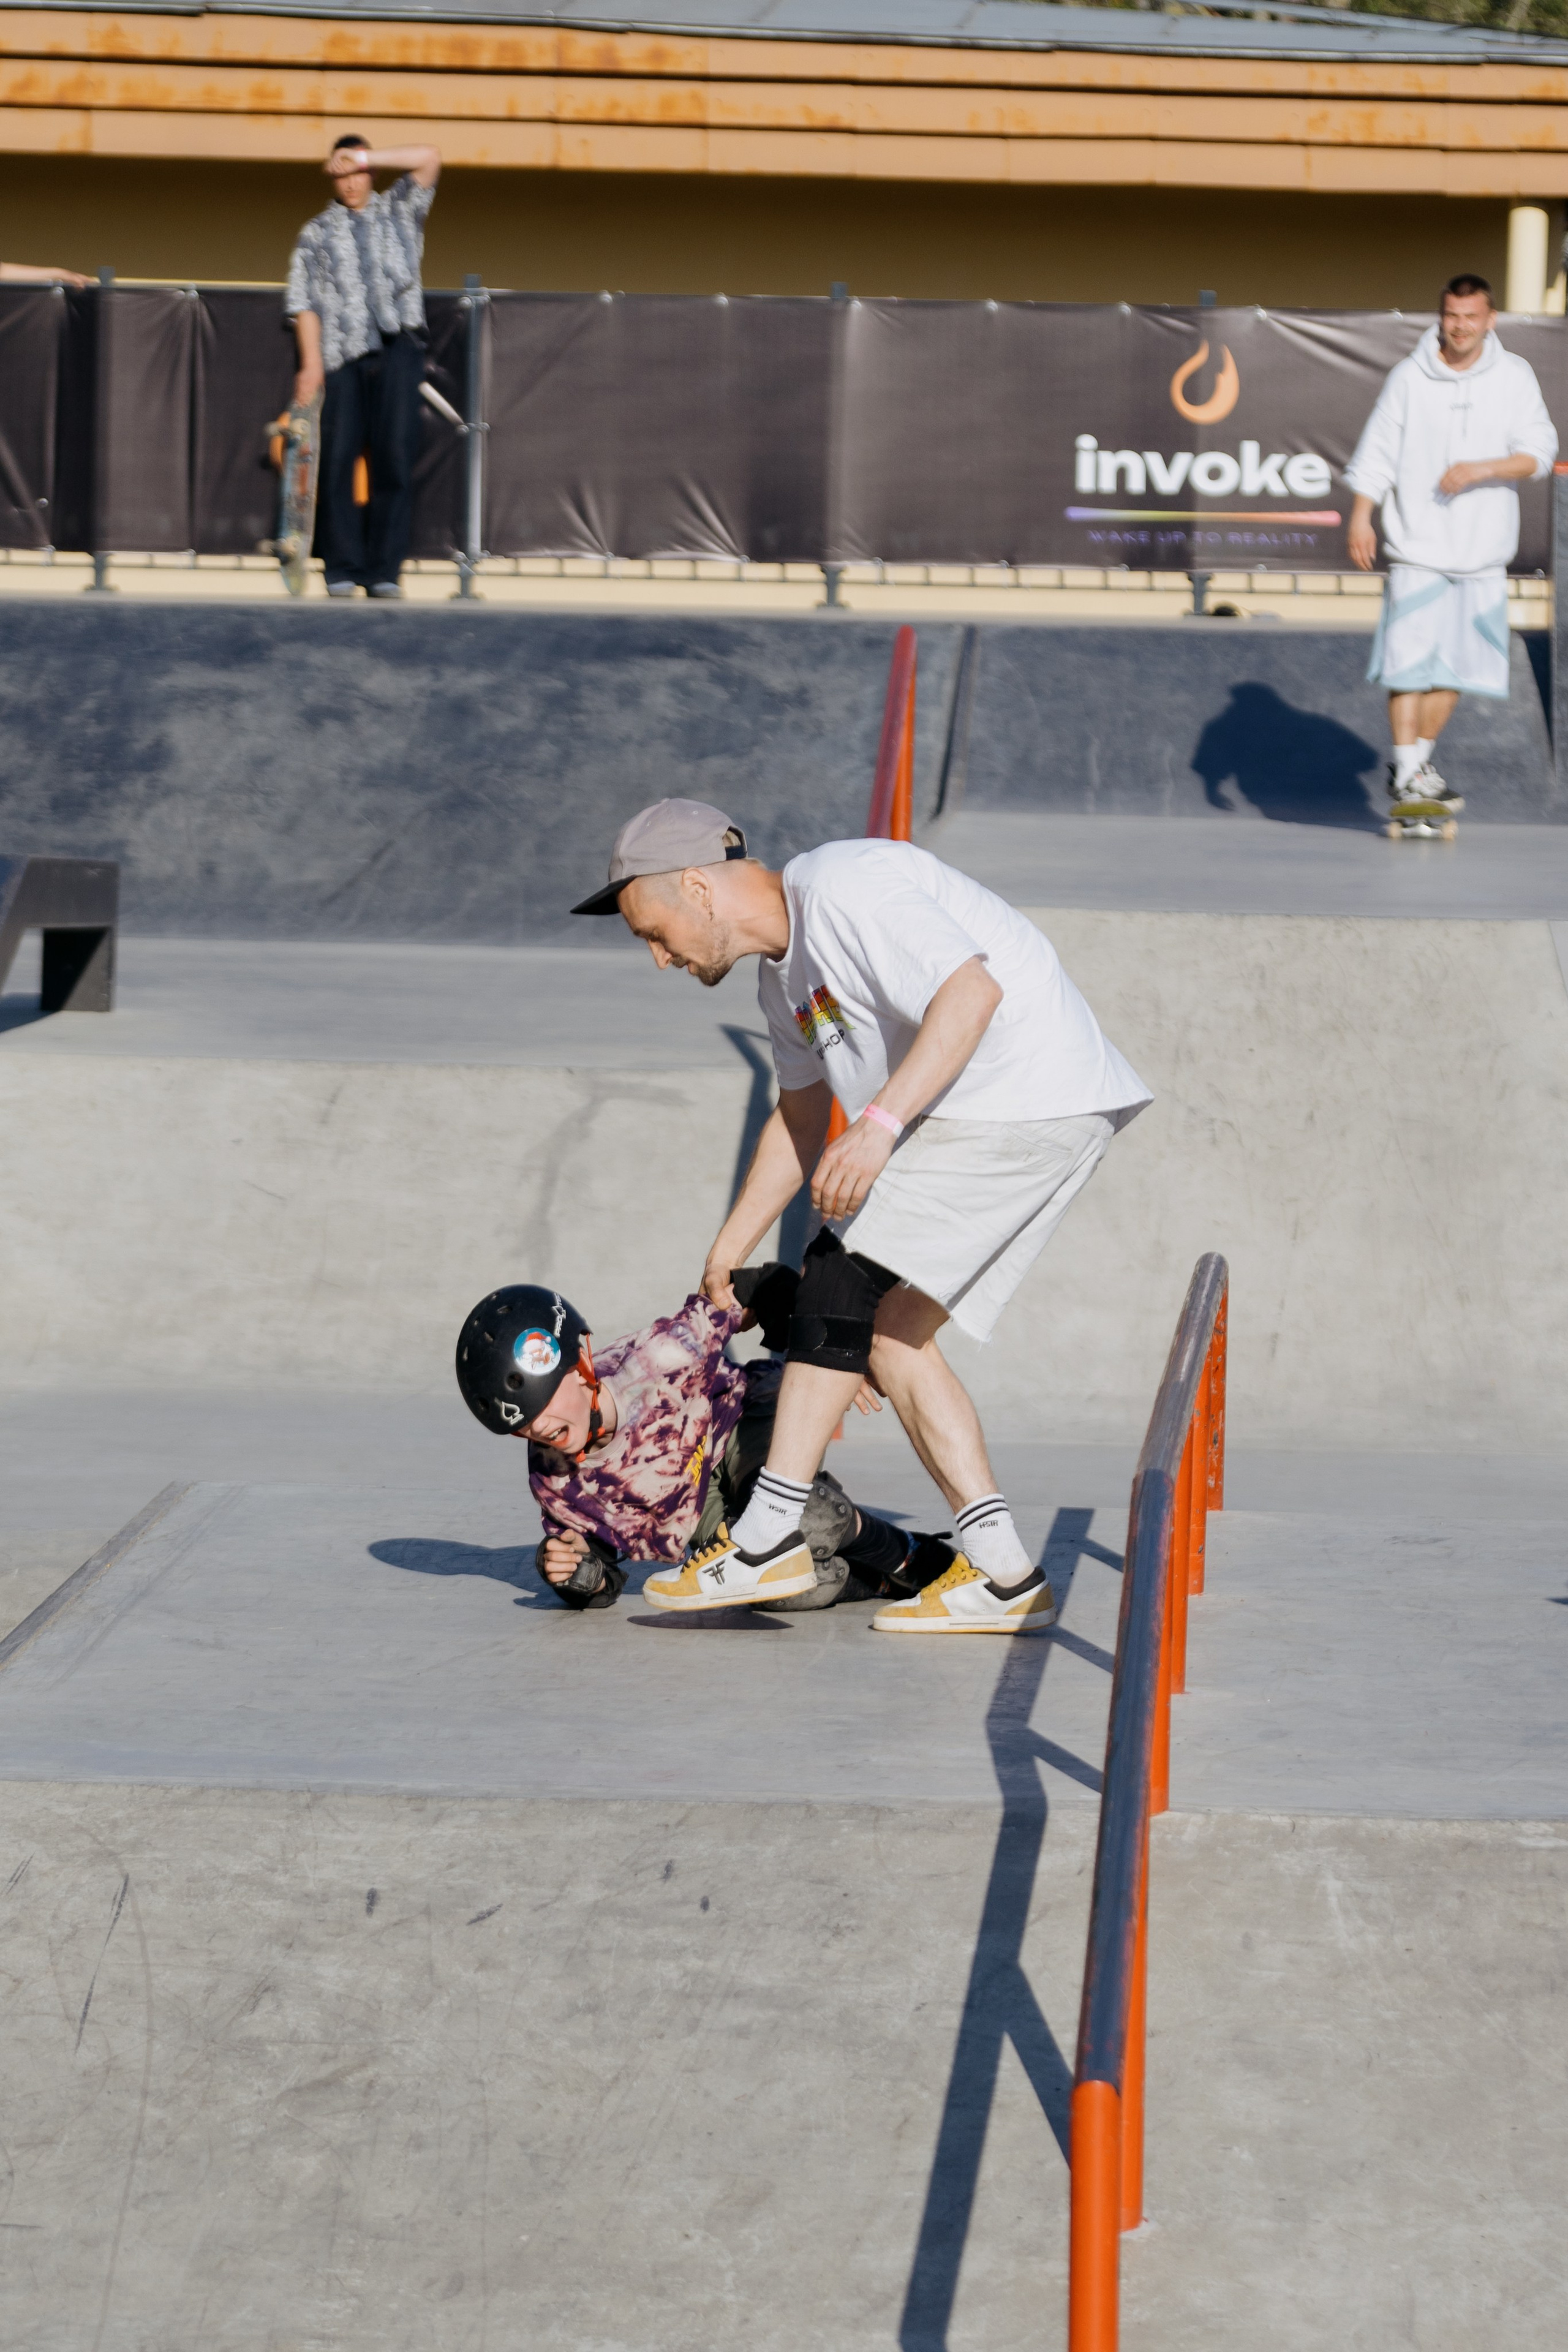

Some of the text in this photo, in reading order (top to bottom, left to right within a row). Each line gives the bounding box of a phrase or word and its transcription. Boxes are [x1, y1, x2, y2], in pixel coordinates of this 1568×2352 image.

[1075, 434, 1332, 498] invoke
[1157, 530, 1186, 545] UP
[1193, 532, 1223, 546] TO
[1227, 532, 1318, 548] REALITY
